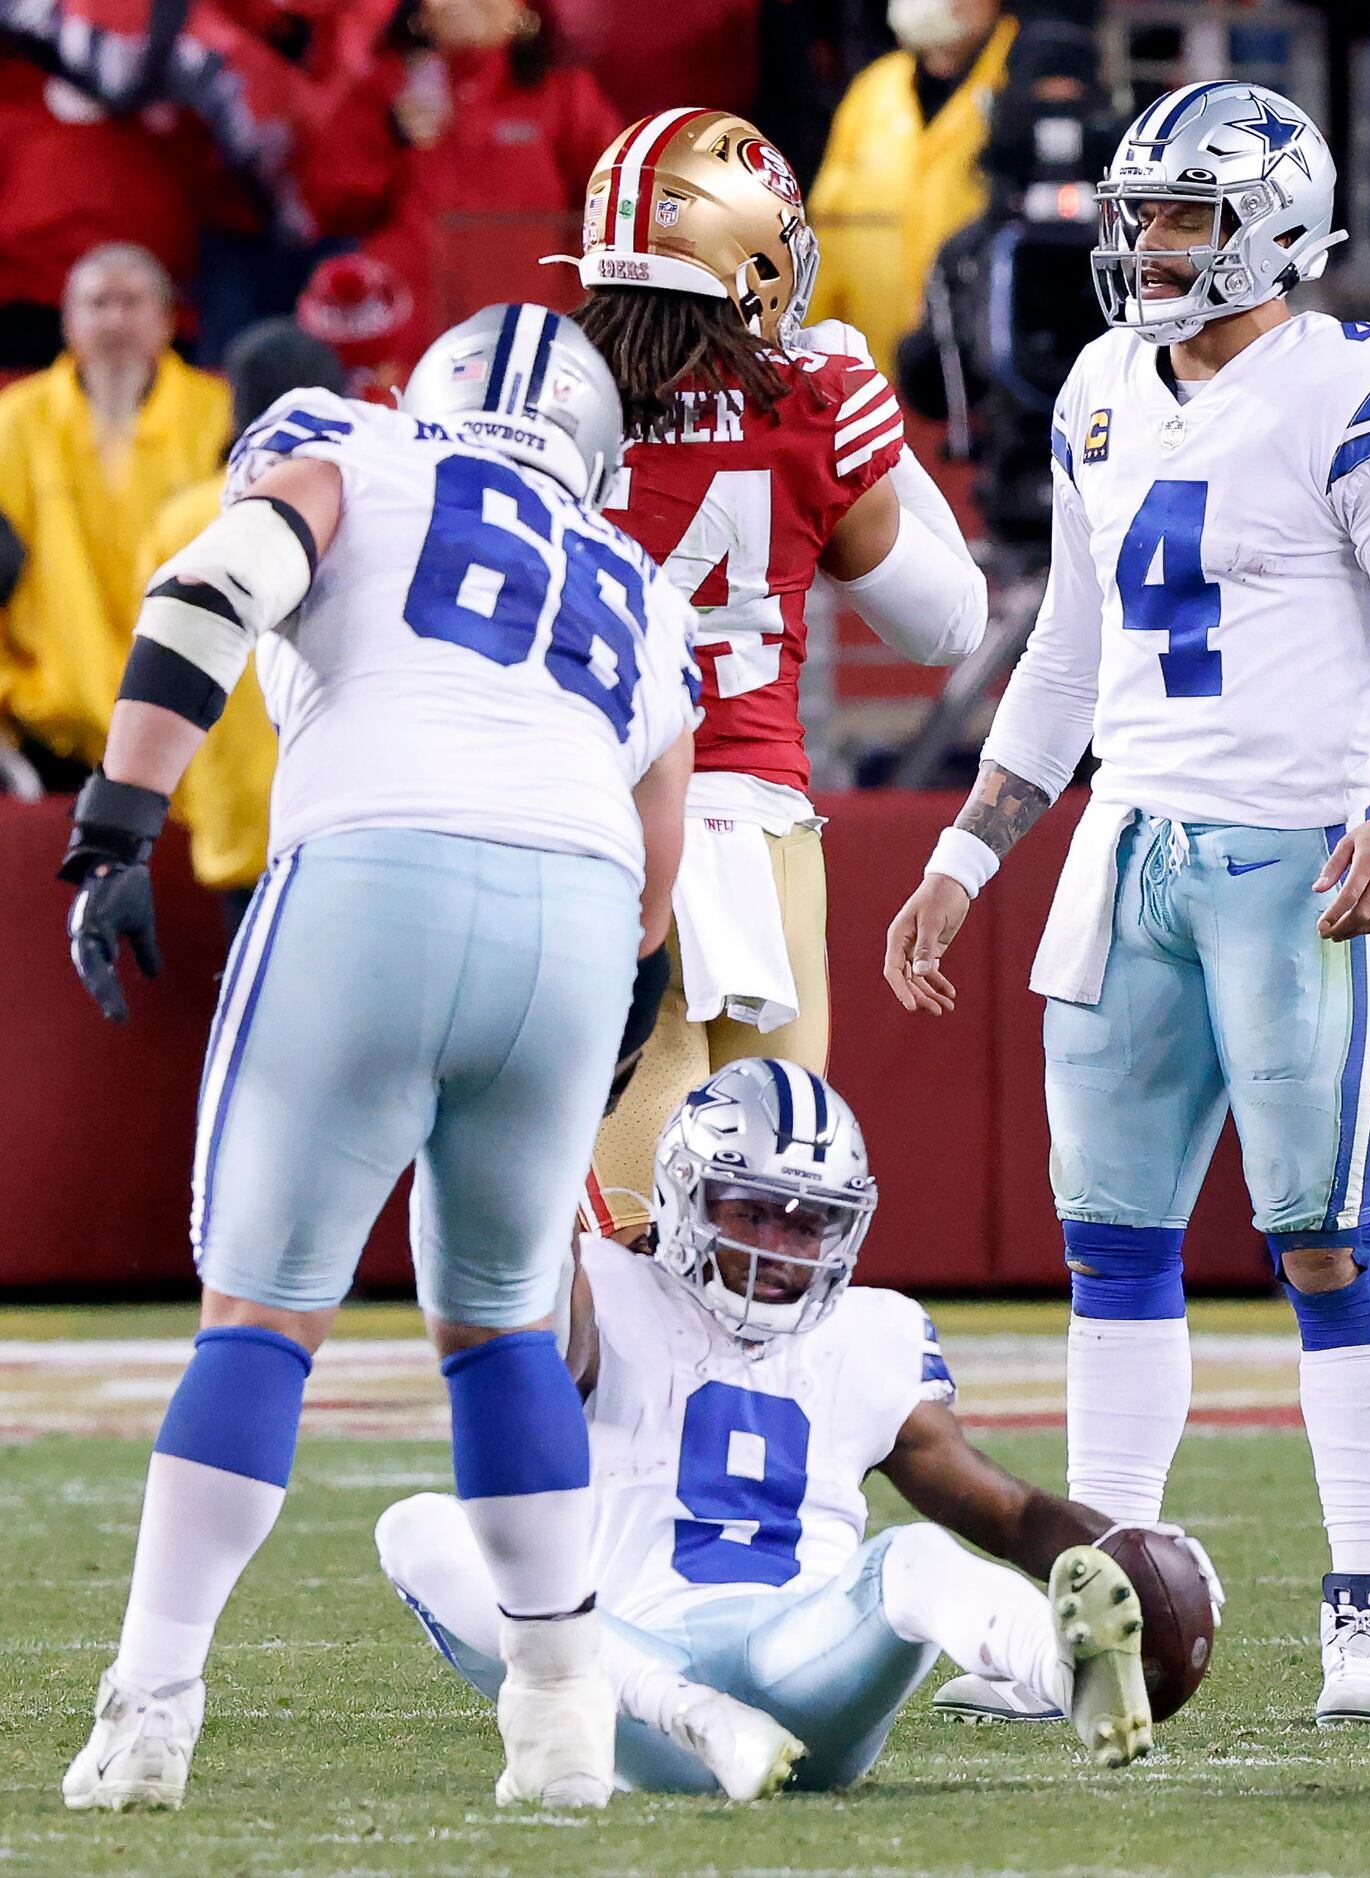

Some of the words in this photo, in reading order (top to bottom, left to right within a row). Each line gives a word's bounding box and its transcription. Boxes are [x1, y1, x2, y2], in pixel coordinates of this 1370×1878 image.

[598, 259, 650, 281] 49ERS
[1085, 411, 1109, 449] C
[403, 453, 648, 744] 66
[1115, 479, 1223, 698] 4
[706, 818, 732, 831] NFL
[671, 1379, 811, 1588] 9
